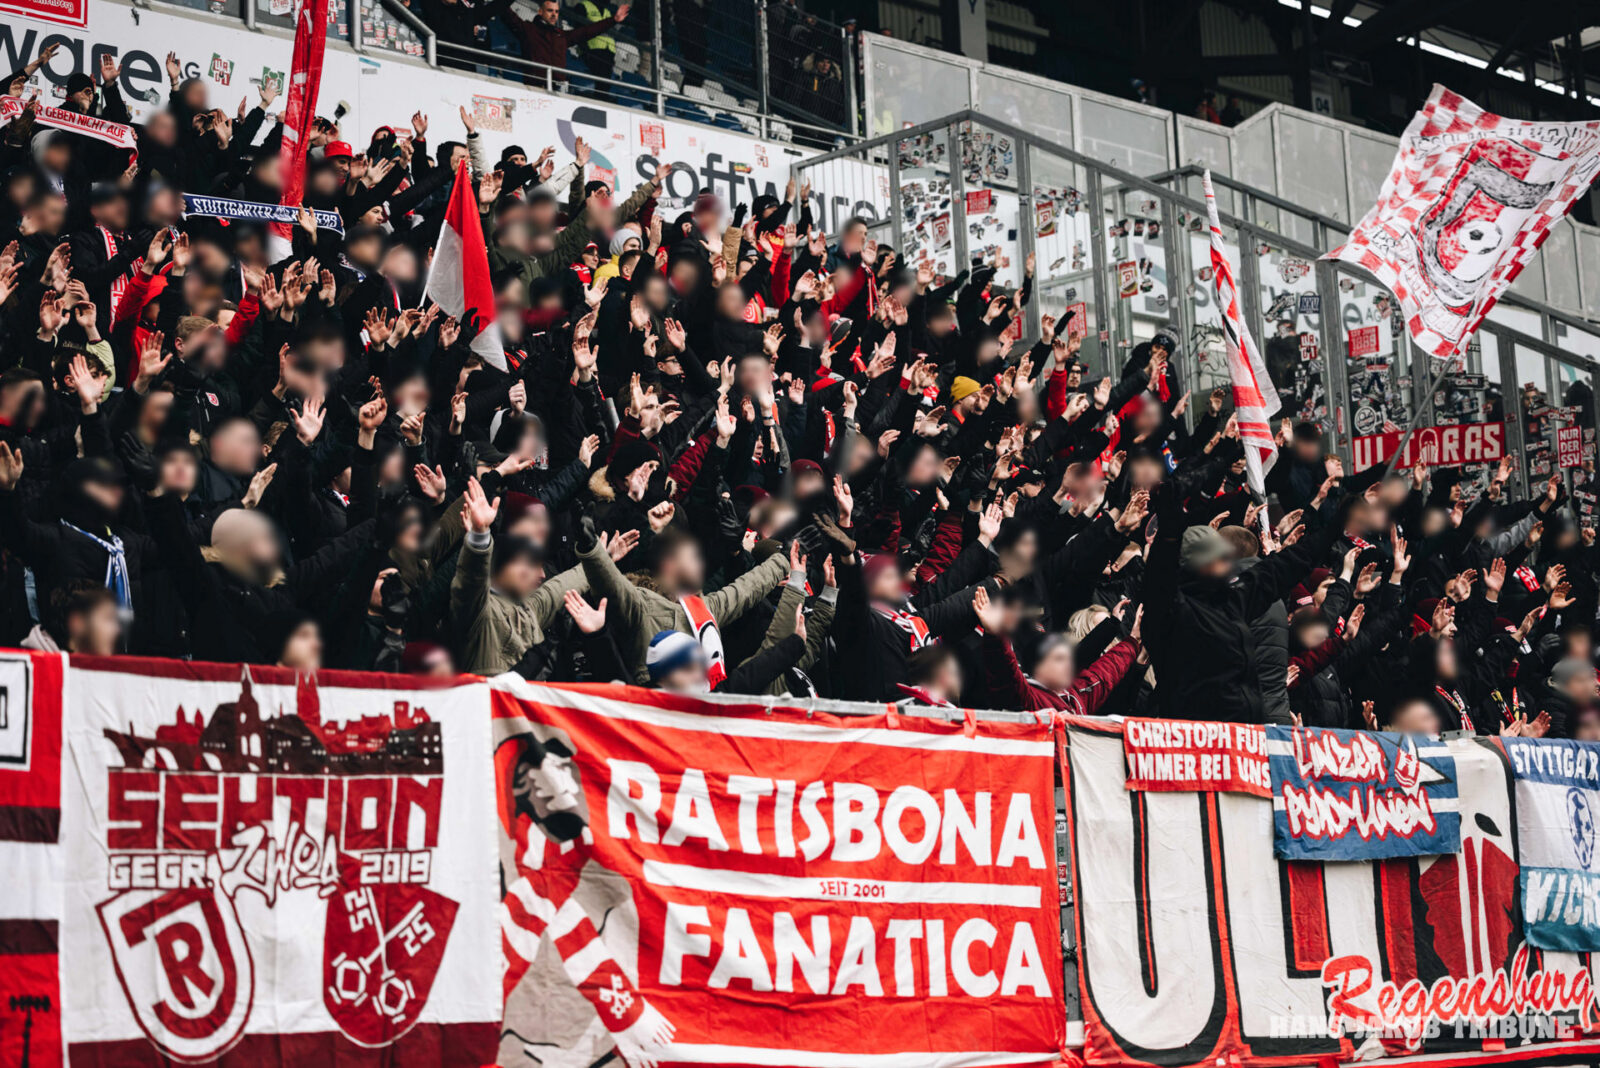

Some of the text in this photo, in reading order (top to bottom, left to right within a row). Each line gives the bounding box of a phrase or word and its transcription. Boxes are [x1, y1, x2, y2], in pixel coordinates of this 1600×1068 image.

[45, 106, 77, 123] GEBEN
[77, 114, 107, 131] NICHT
[106, 124, 127, 138] AUF
[192, 198, 274, 218] STUTTGARTER
[1559, 429, 1579, 440] NUR
[1560, 441, 1579, 453] DER
[1561, 453, 1580, 466] SSV
[1127, 720, 1268, 756] CHRISTOPH FÜR
[1129, 753, 1271, 788] IMMER BEI UNS
[606, 758, 1047, 869] RATISBONA
[360, 850, 432, 885] 2019
[820, 881, 886, 898] SEIT 2001
[659, 902, 1053, 998] FANATICA
[1321, 941, 1594, 1049] Regensburg
